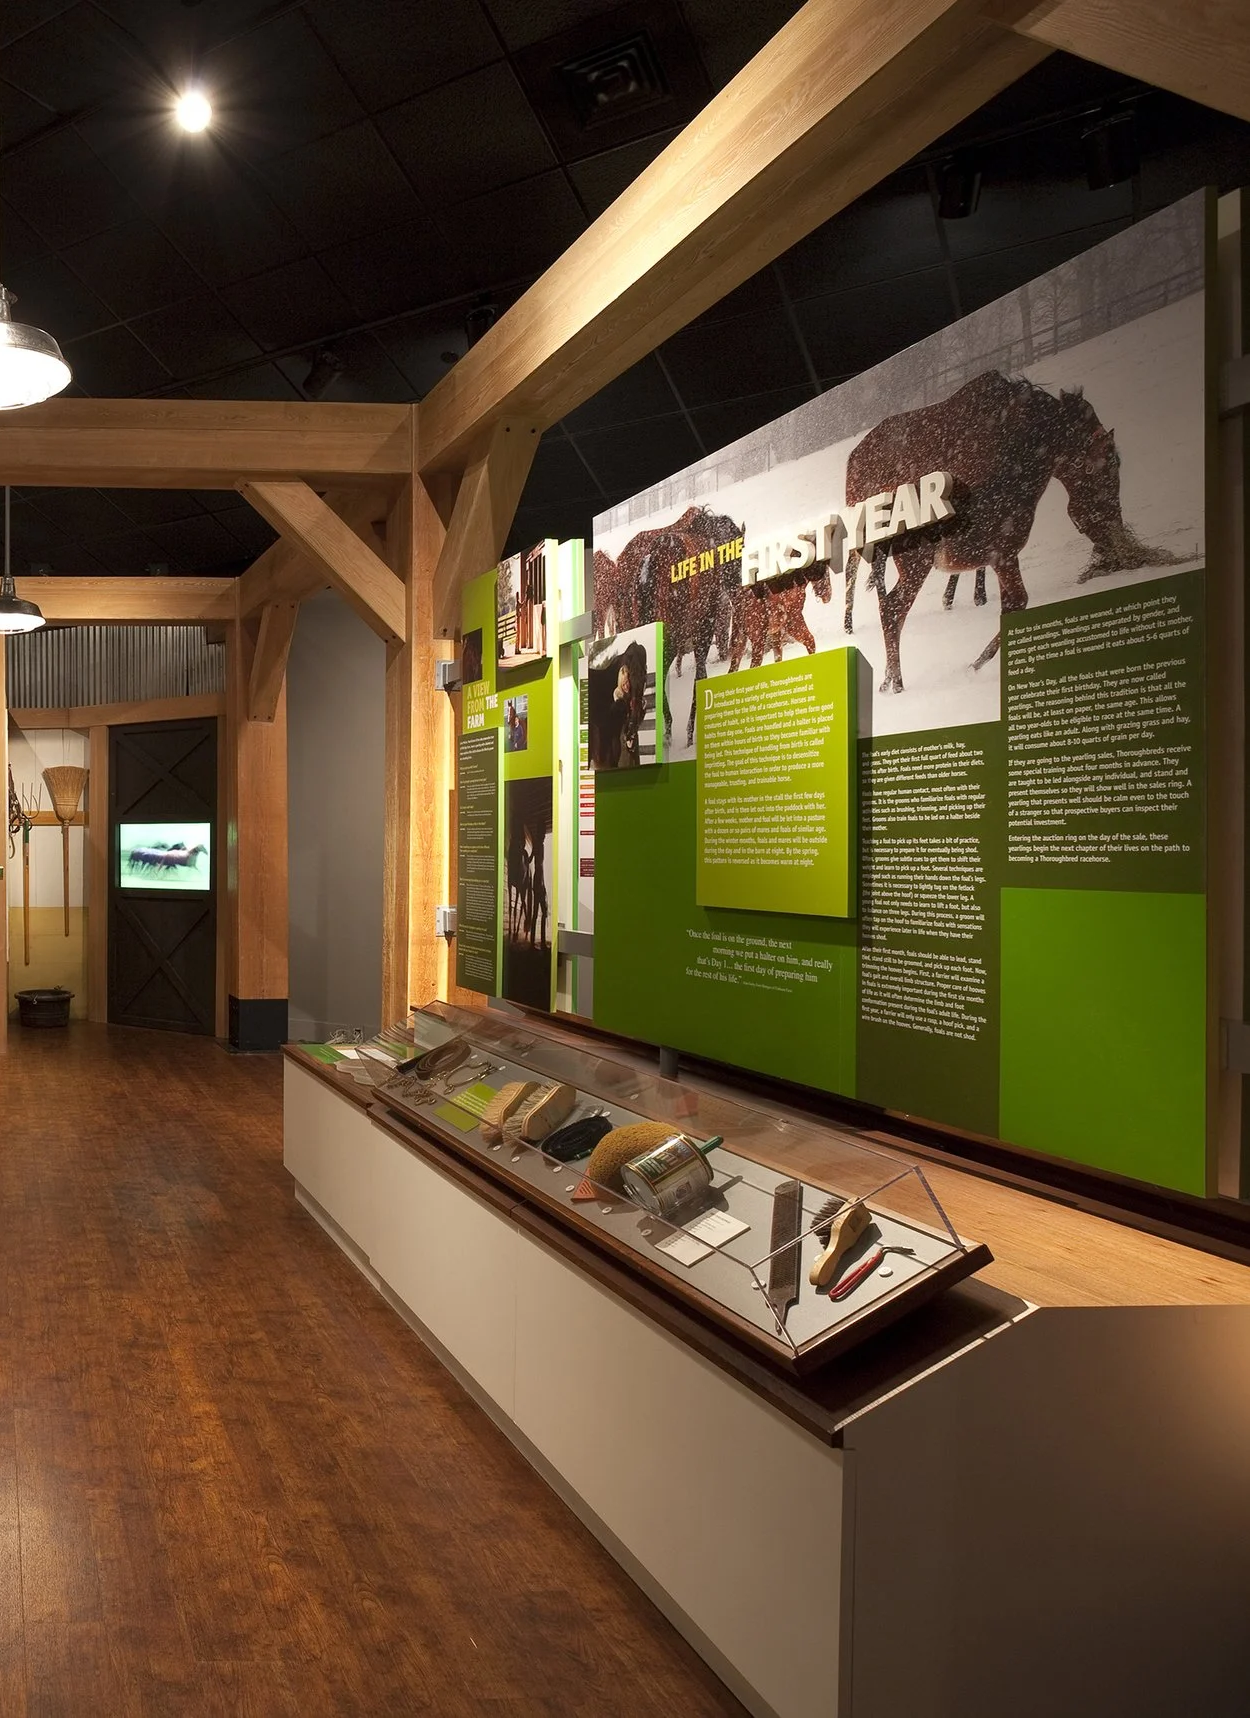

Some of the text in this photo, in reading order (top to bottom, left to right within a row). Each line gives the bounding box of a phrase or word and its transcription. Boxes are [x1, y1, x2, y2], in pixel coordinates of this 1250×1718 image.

[670, 471, 955, 587] LIFE IN THE FIRST YEAR
[1123, 603, 1141, 611] which
[1143, 599, 1160, 609] point
[468, 680, 490, 699] A VIEW
[468, 693, 498, 714] FROM THE
[468, 714, 484, 729] FARM
[712, 947, 734, 958] morning
[744, 951, 753, 960] put
[759, 952, 776, 961] halter
[801, 957, 812, 966] and
[814, 959, 832, 971] really
